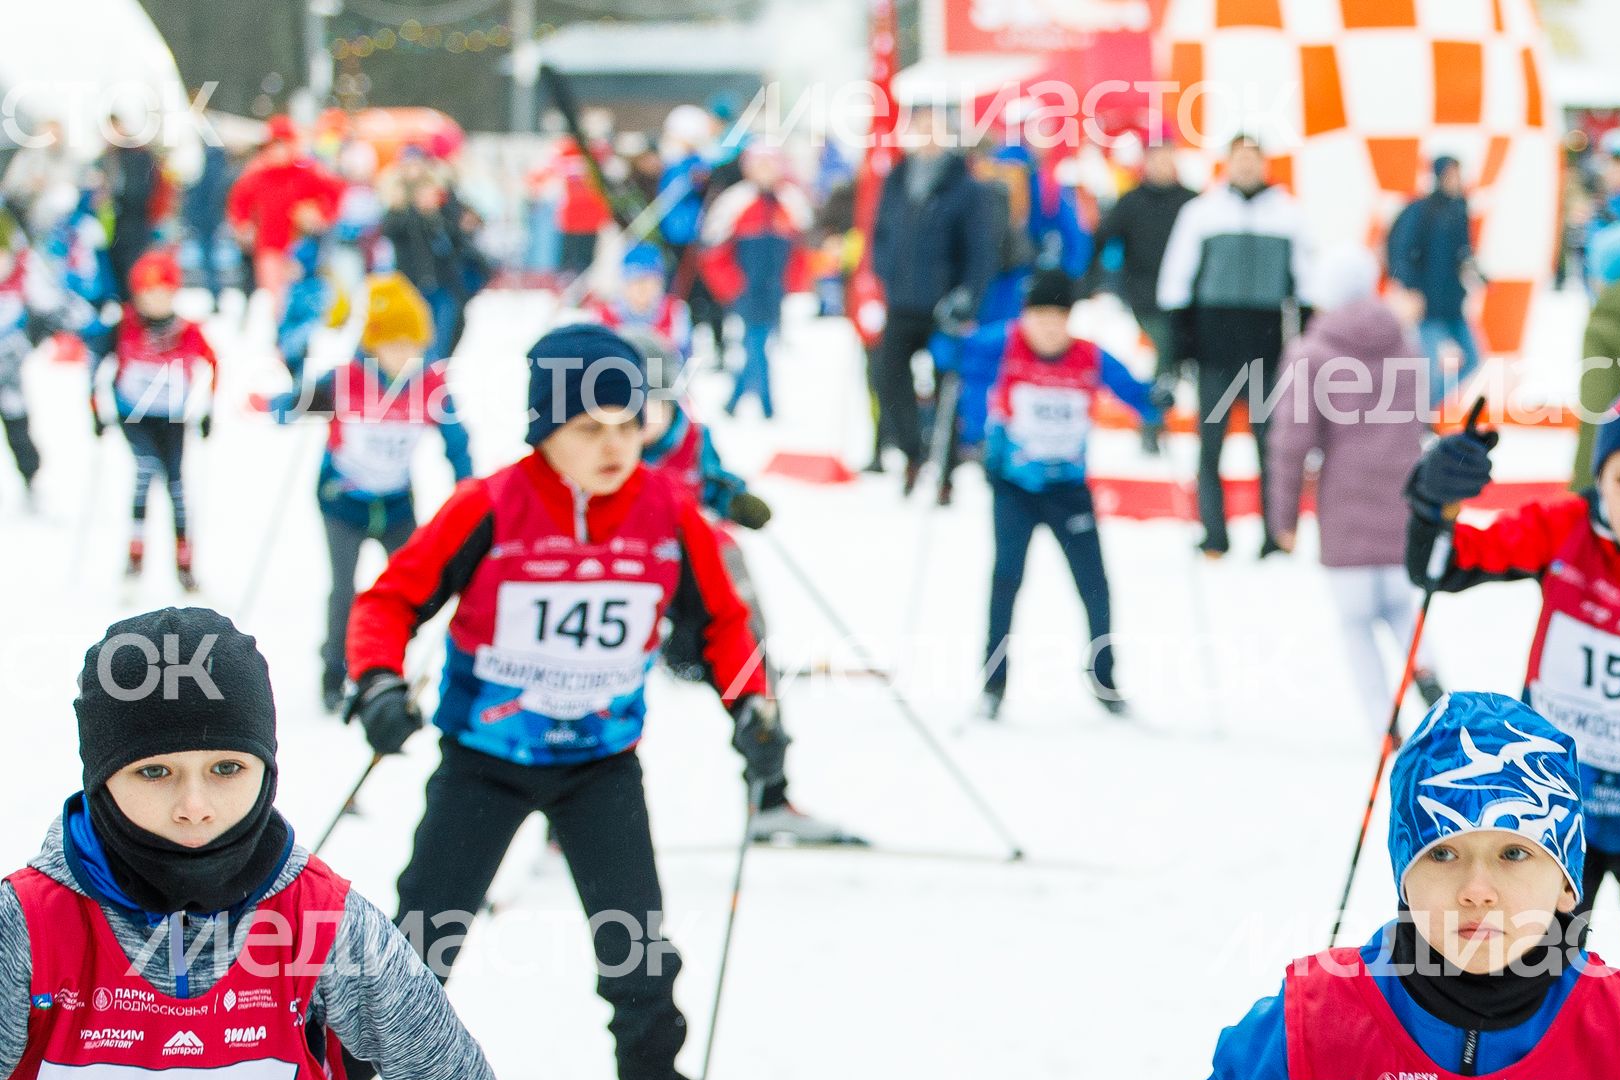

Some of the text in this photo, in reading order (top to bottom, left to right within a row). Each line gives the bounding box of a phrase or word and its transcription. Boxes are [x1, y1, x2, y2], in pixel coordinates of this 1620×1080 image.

[534, 599, 627, 649] 145
[114, 987, 155, 1003] ПАРКИ
[113, 1000, 209, 1016] ПОДМОСКОВЬЯ
[80, 1028, 145, 1042] УРАЛХИМ
[224, 1025, 267, 1044] ЗИМА
[162, 1044, 204, 1056] marsport
